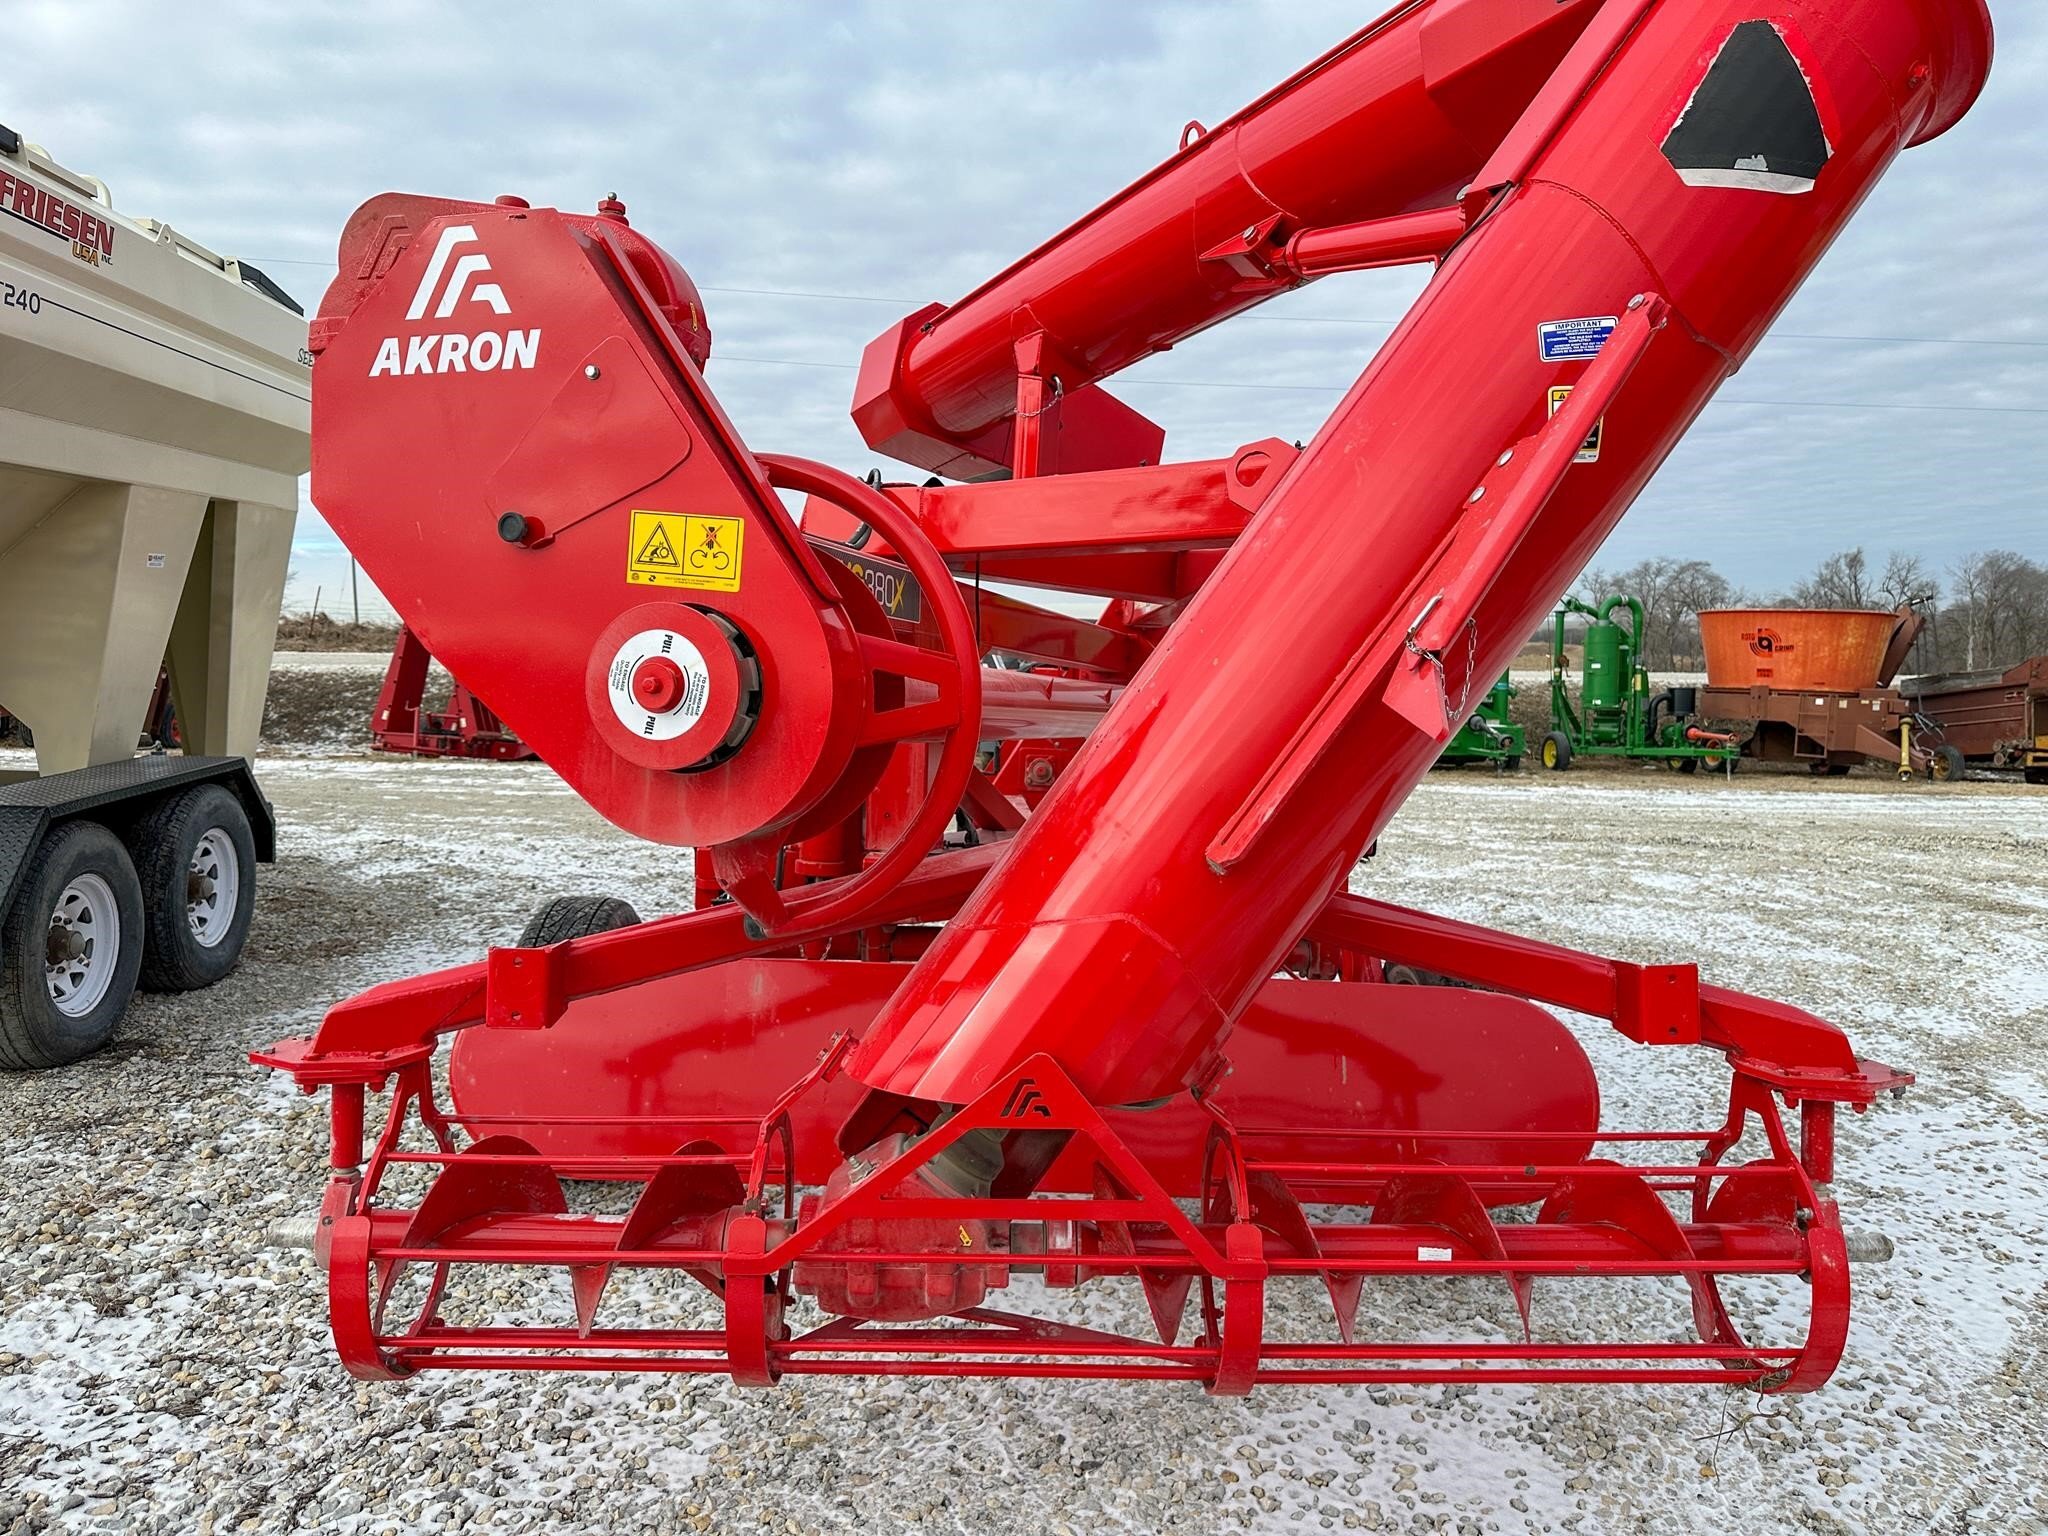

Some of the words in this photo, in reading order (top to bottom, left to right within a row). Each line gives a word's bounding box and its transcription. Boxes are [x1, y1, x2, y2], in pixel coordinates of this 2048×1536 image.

[0, 170, 114, 256] FRIESEN
[72, 241, 99, 267] USA
[101, 254, 113, 265] INC.
[1555, 321, 1601, 330] IMPORTANT
[297, 347, 314, 367] SEE
[368, 328, 541, 377] AKRON
[661, 634, 674, 654] PULL
[644, 715, 656, 735] PULL
